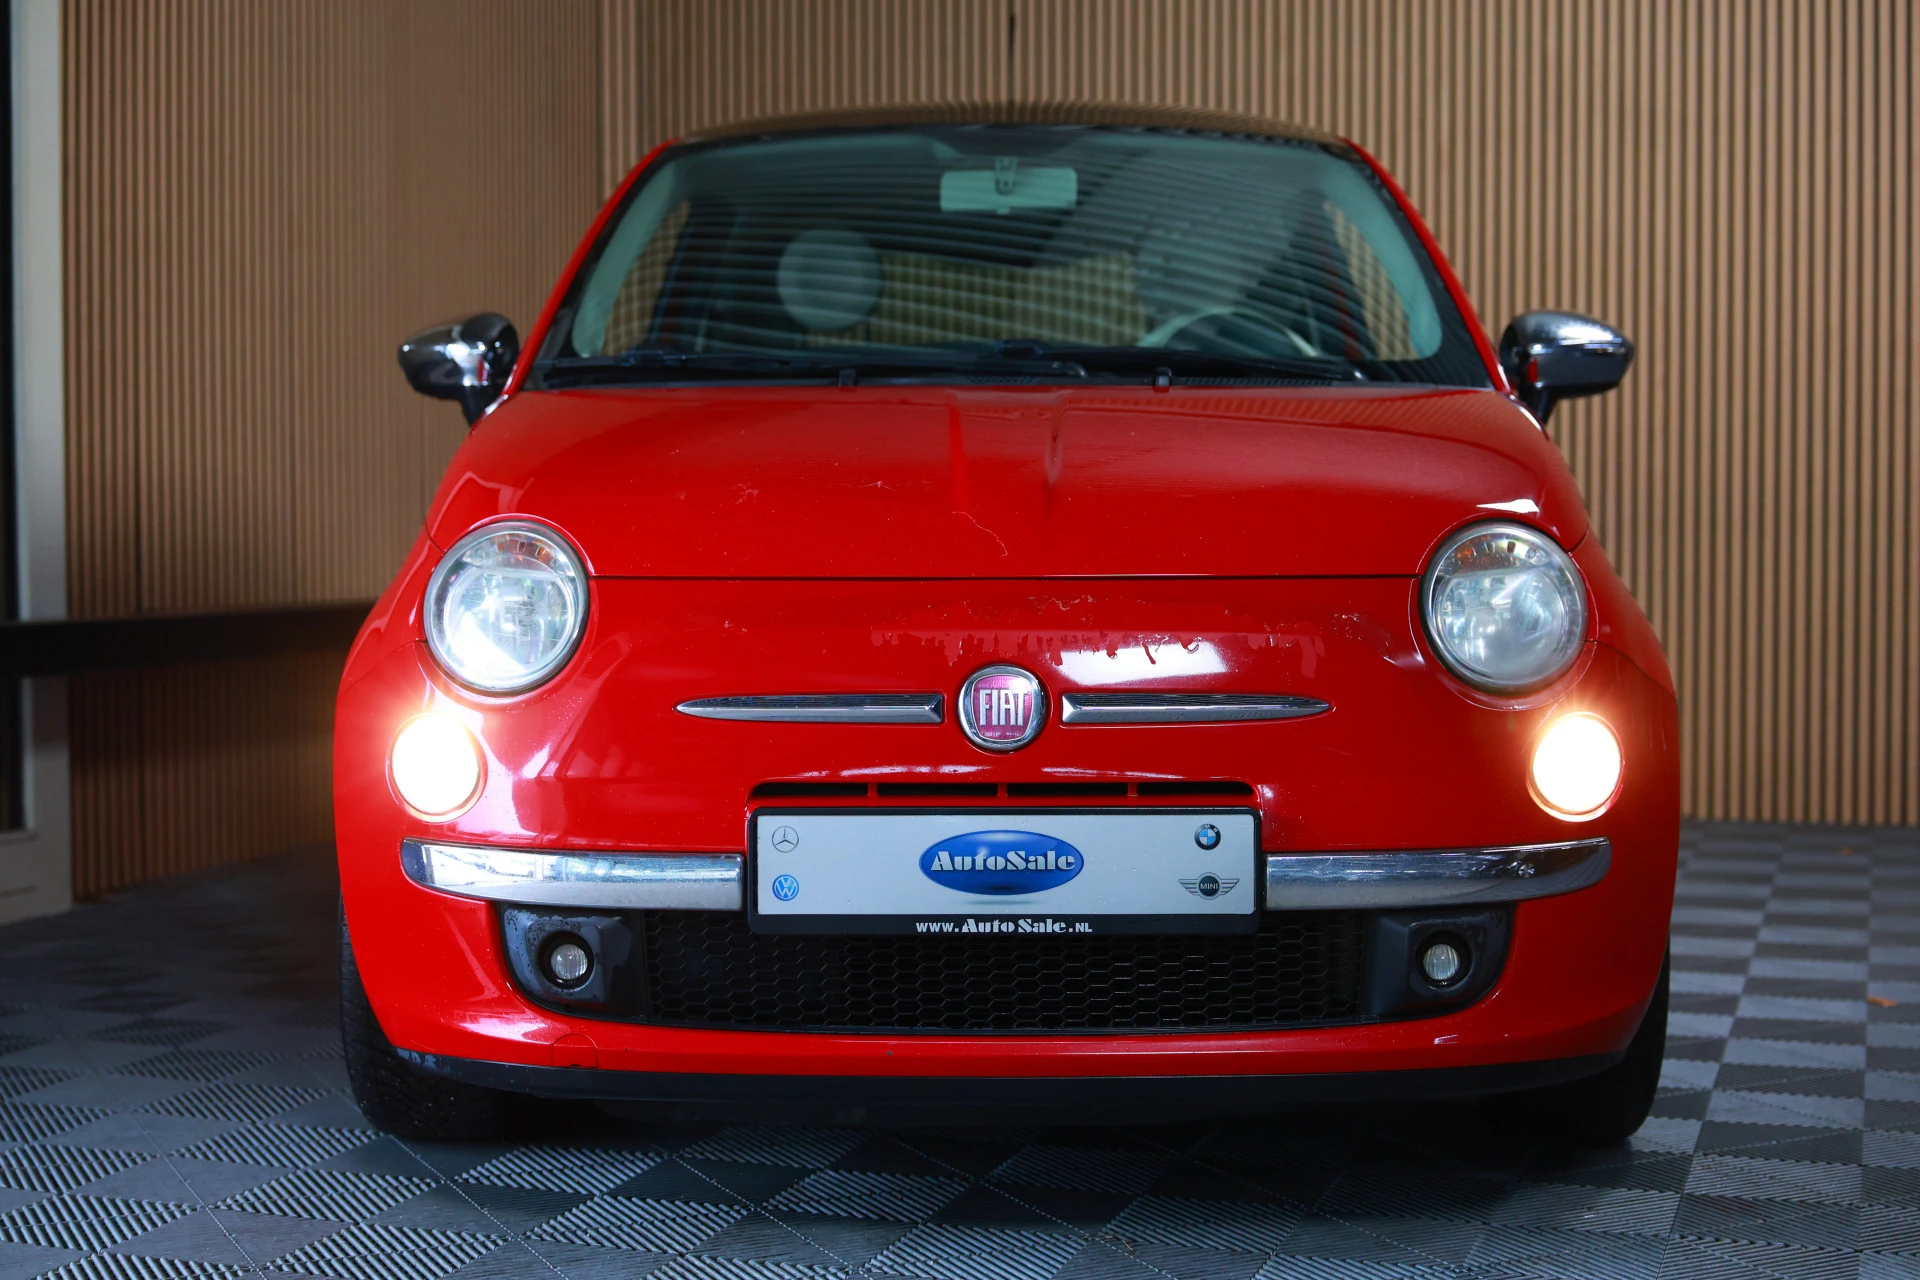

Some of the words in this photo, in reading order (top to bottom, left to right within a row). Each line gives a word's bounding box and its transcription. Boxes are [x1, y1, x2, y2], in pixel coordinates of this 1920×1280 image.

[979, 689, 1028, 727] FIAT
[931, 850, 1076, 871] AutoSale
[1200, 882, 1219, 890] MINI
